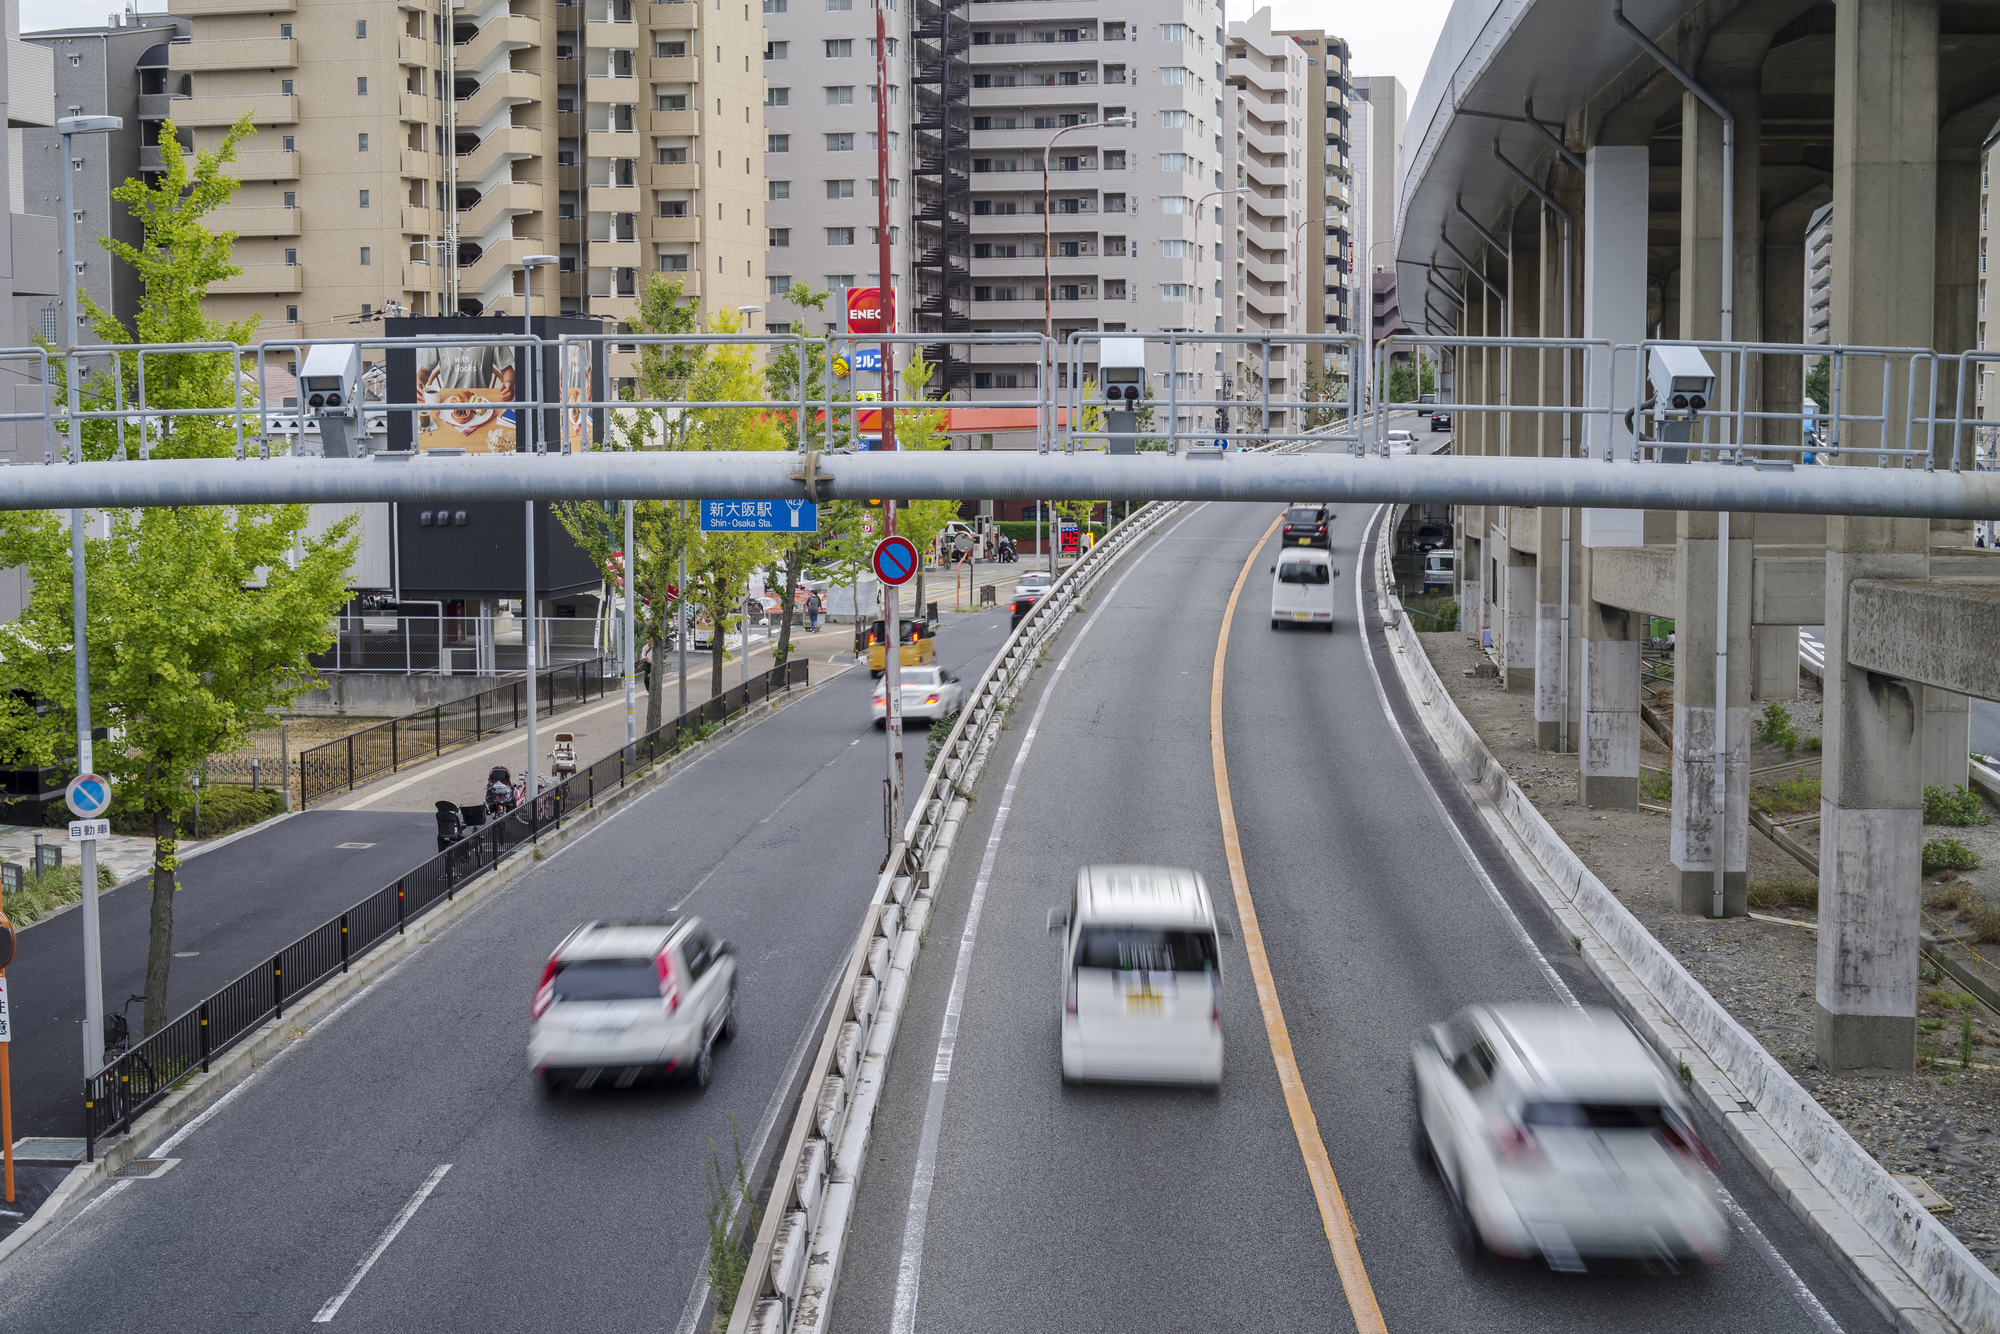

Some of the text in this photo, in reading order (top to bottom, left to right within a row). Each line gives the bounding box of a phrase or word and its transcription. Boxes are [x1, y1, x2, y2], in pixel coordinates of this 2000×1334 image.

[454, 355, 470, 363] with
[454, 364, 477, 372] Books
[709, 502, 773, 517] 新大阪駅
[758, 518, 773, 527] Sta.
[71, 824, 108, 837] 自動車
